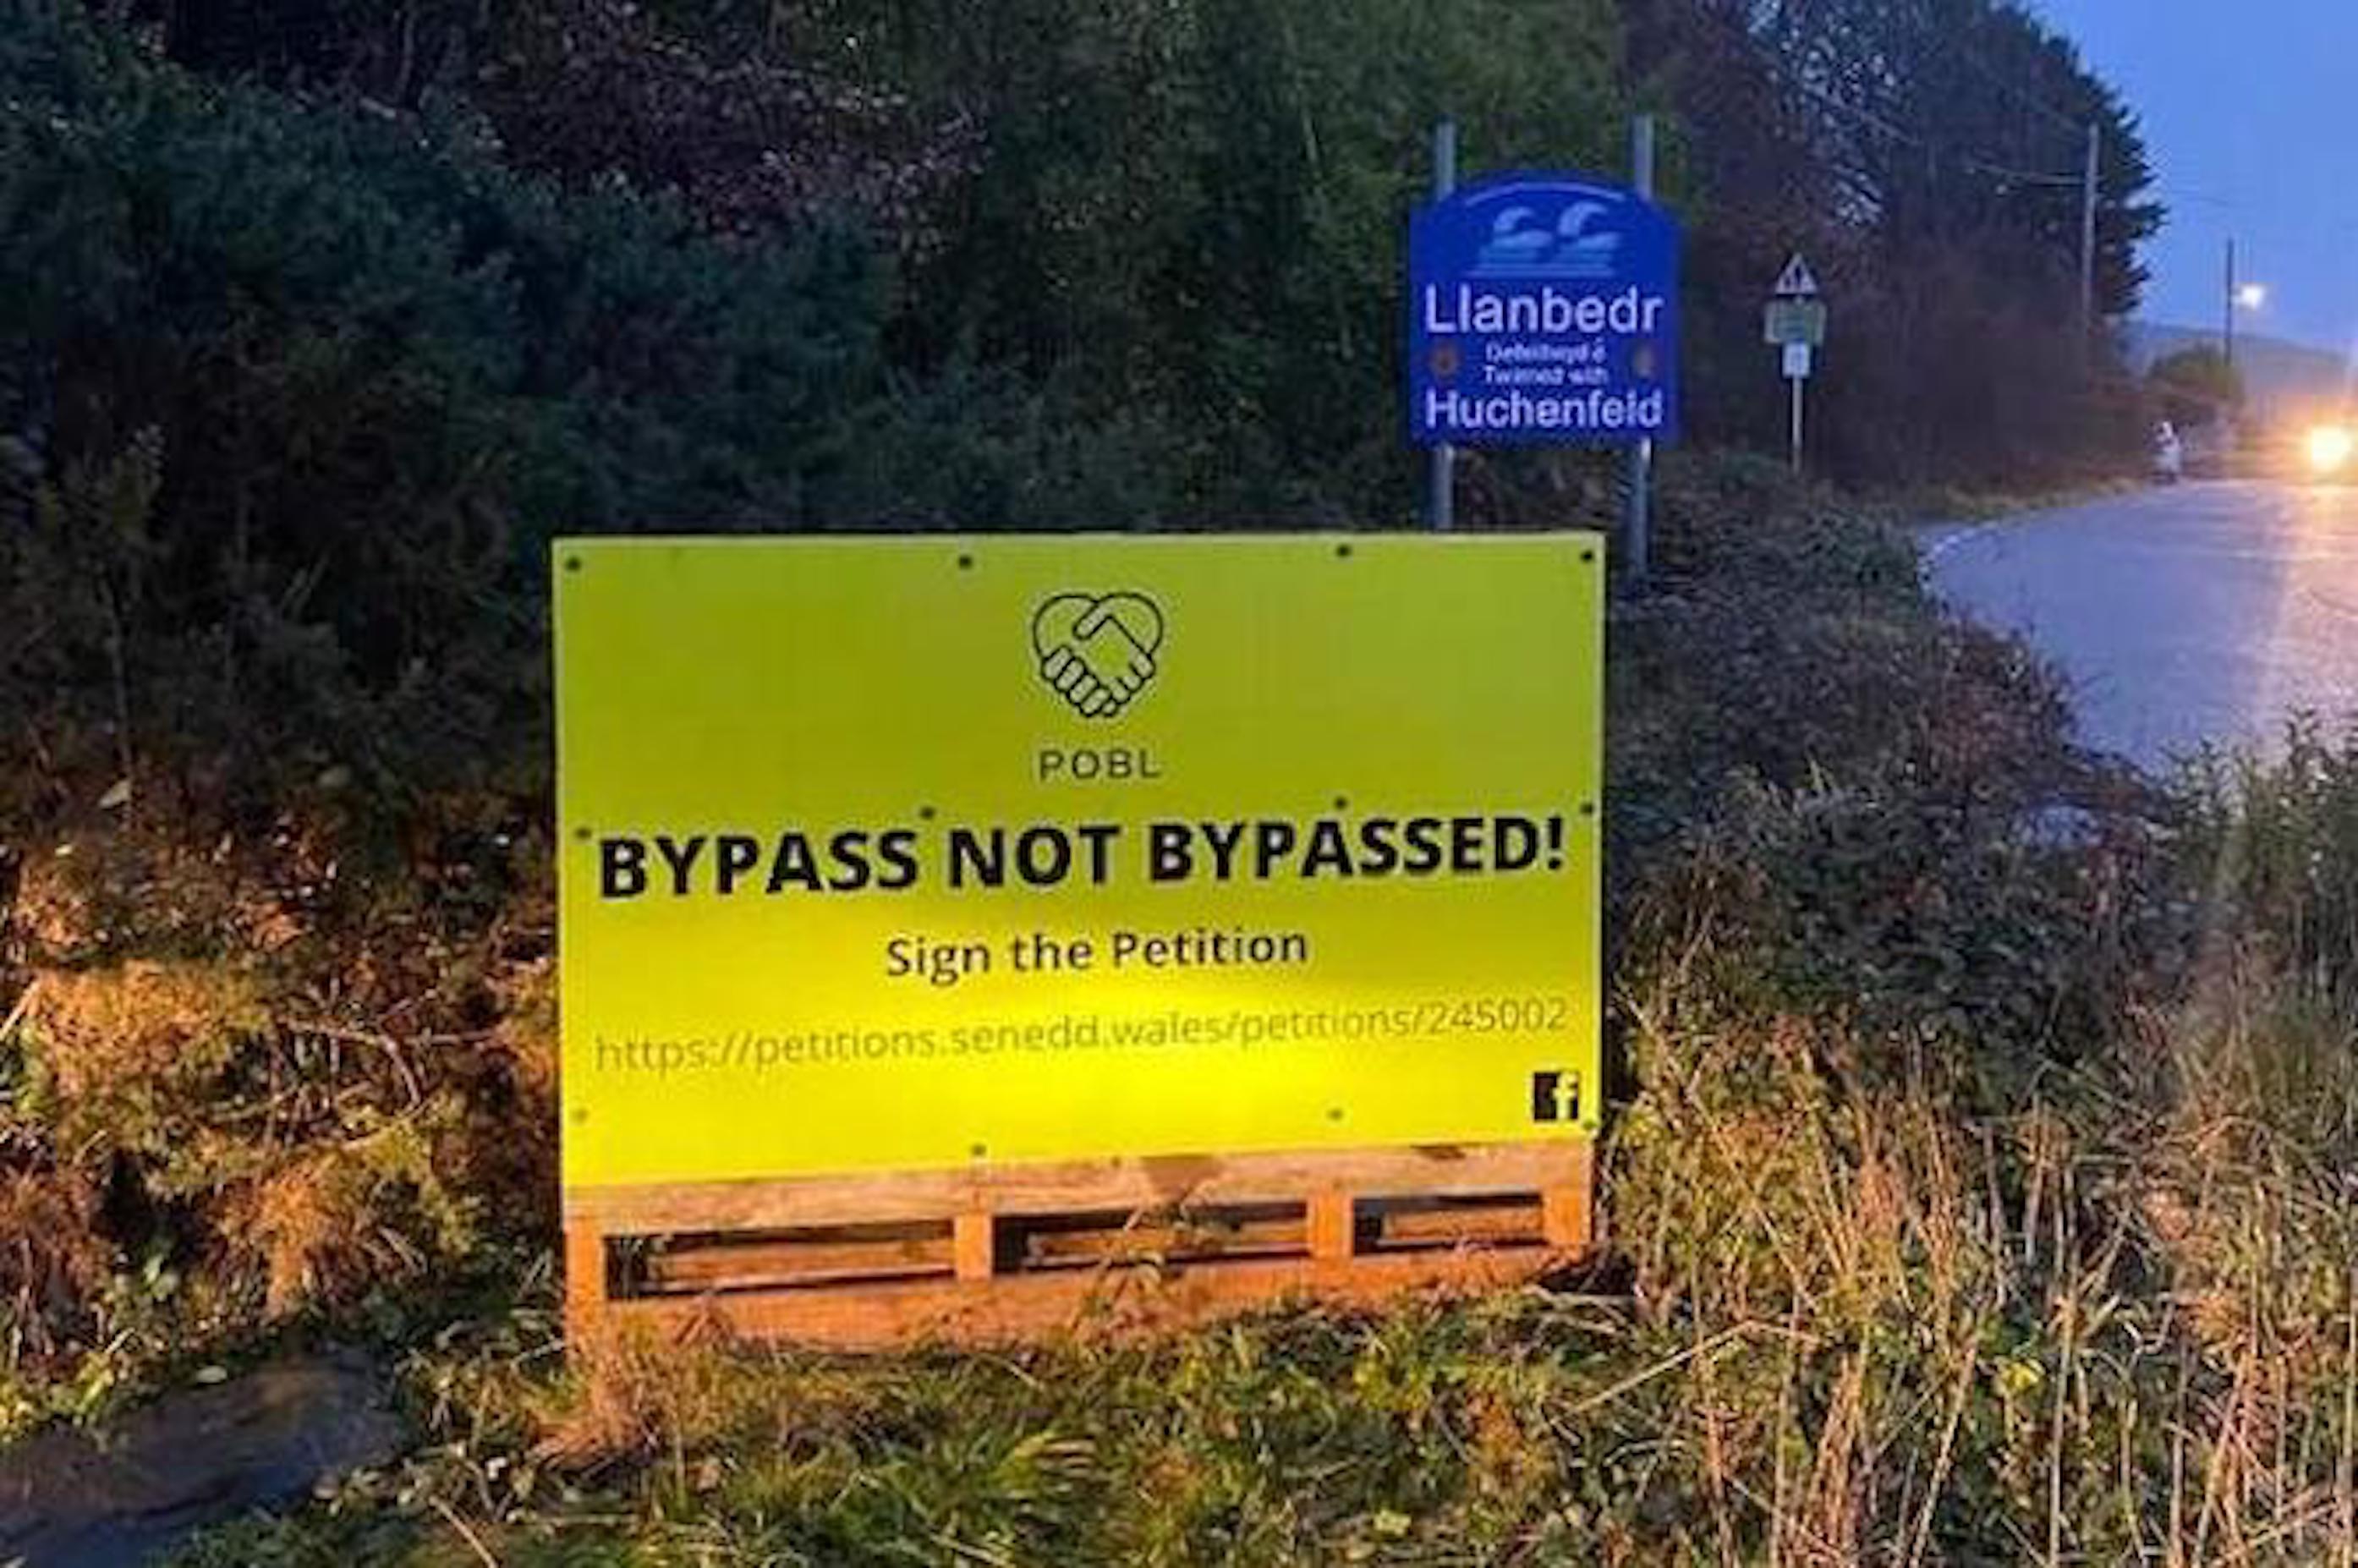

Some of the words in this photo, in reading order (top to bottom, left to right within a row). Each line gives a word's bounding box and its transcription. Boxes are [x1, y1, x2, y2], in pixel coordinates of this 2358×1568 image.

[1424, 283, 1664, 333] Llanbedr
[1424, 388, 1664, 428] Huchenfeld
[1039, 749, 1160, 780] POBL
[600, 832, 918, 898] BYPASS
[948, 825, 1121, 888] NOT
[1150, 817, 1564, 882] BYPASSED!
[886, 936, 990, 985] Sign
[1014, 934, 1093, 971] the
[1112, 927, 1308, 967] Petition
[595, 996, 1567, 1076] https://petitions.senedd.wales/petitions/245002
